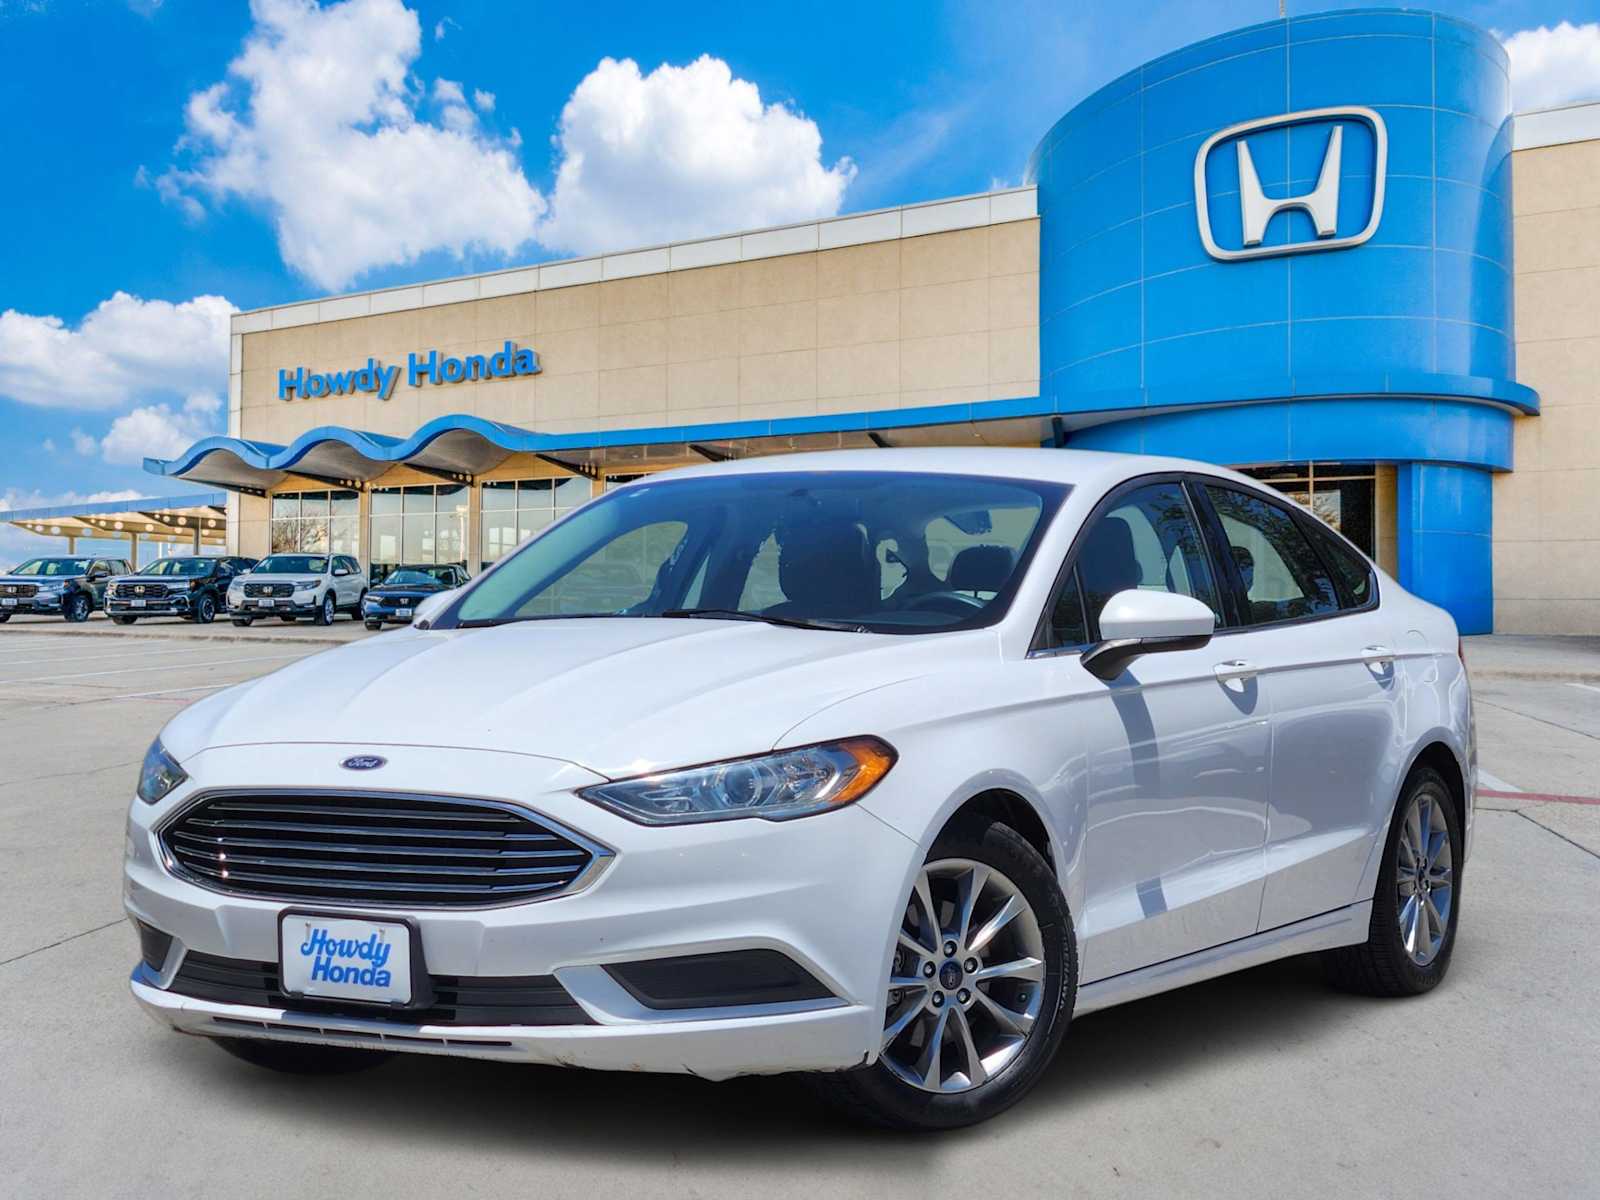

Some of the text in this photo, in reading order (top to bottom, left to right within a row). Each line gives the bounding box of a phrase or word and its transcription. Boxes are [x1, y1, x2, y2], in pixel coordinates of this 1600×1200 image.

[278, 341, 541, 400] Howdy Honda
[301, 928, 391, 967] Howdy
[312, 956, 391, 987] Honda
